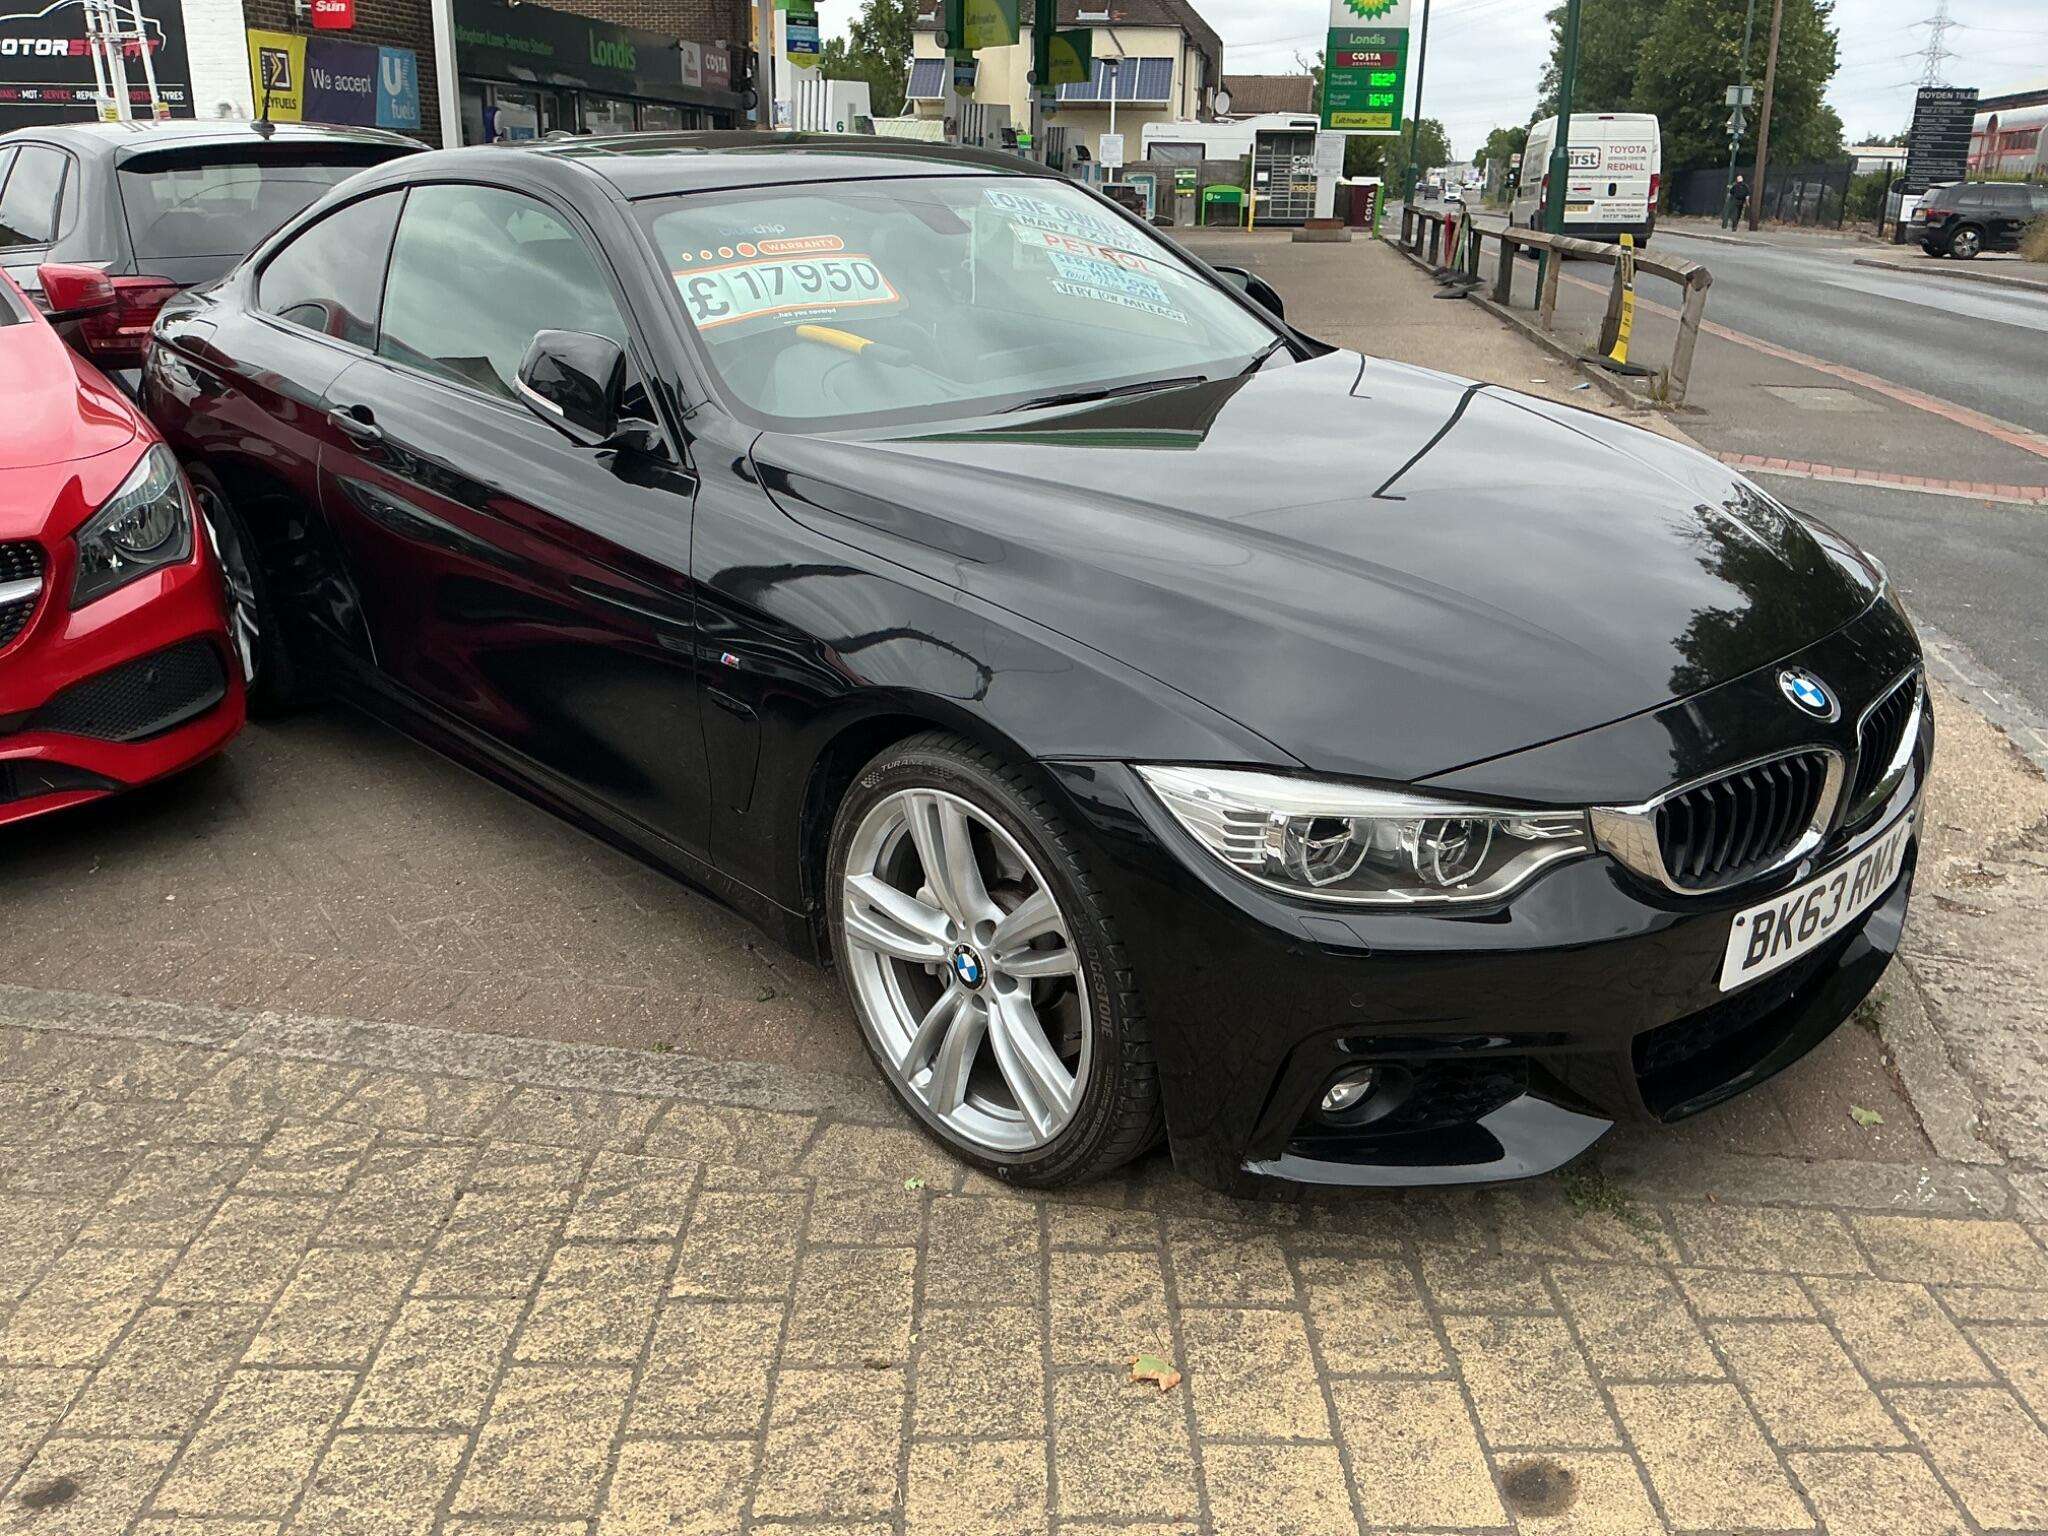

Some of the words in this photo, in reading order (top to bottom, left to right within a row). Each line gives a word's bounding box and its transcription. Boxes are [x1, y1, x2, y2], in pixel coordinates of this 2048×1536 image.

[315, 1, 346, 12] Sun
[1349, 32, 1386, 45] Londis
[588, 28, 637, 72] Londis
[1352, 53, 1381, 61] COSTA
[705, 53, 728, 73] COSTA
[311, 68, 331, 91] We
[335, 73, 373, 98] accept
[22, 89, 38, 99] MOT
[42, 90, 71, 100] SERVICE
[161, 90, 184, 100] TYRES
[1919, 91, 1954, 99] BOYDEN
[391, 99, 415, 119] fuels
[836, 121, 844, 132] 6
[1569, 151, 1597, 165] irst
[1609, 145, 1648, 154] TOYOTA
[1607, 163, 1646, 171] REDHILL
[997, 193, 1050, 216] ONE
[1365, 191, 1375, 221] COSTA
[1021, 215, 1068, 231] MANY
[766, 239, 834, 252] WARRANTY
[1043, 233, 1157, 276] PETROL
[1054, 253, 1127, 276] SERVICE
[687, 261, 880, 320] £17950
[1057, 282, 1092, 297] VERY
[1123, 298, 1183, 320] MILEAGE
[1741, 870, 1849, 971] BK63
